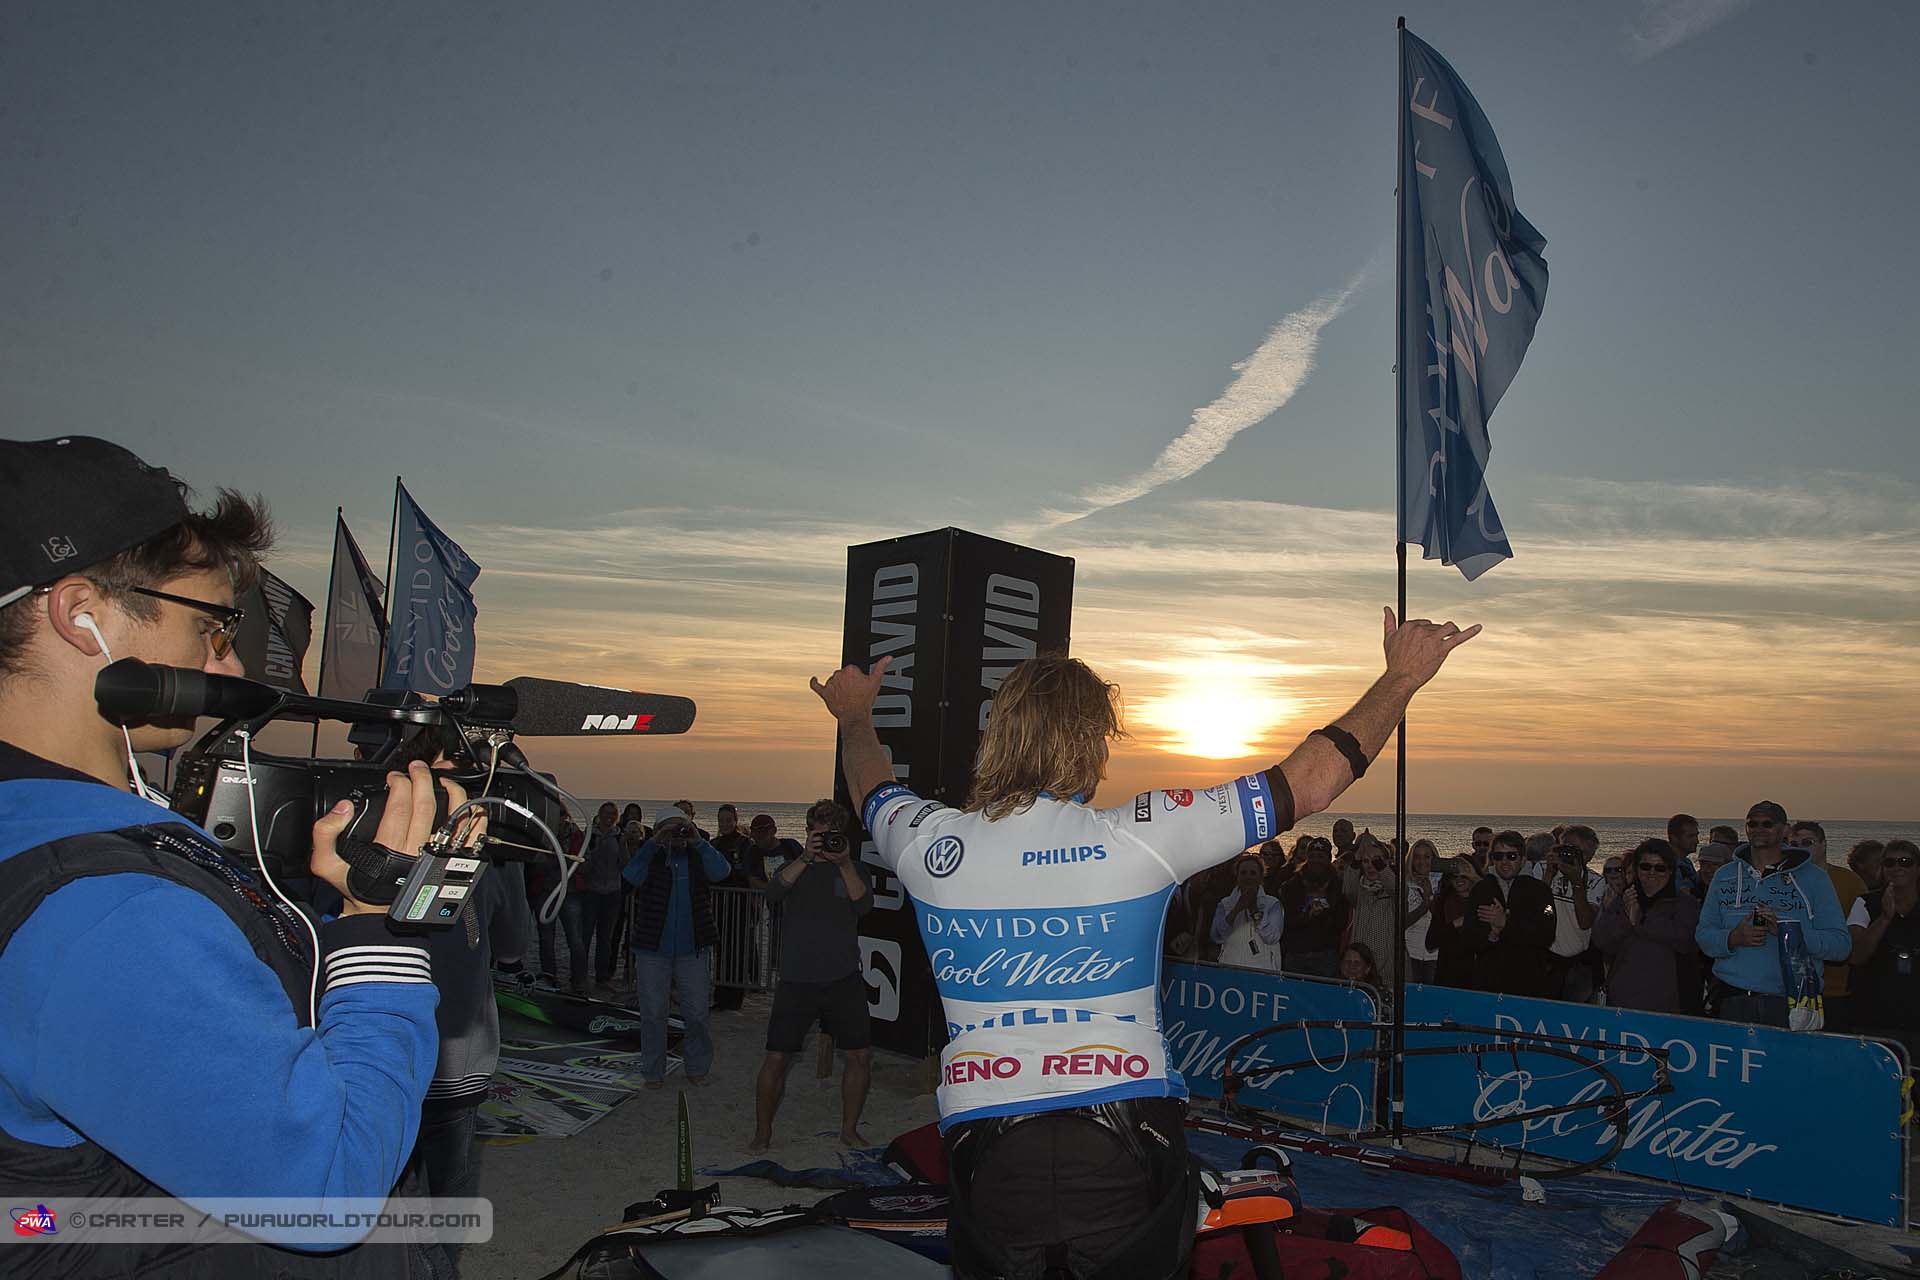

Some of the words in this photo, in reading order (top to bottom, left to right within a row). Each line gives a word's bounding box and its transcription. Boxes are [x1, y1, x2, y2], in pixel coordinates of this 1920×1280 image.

[424, 598, 463, 689] Cool
[869, 562, 919, 728] DAVID
[978, 573, 1040, 730] AVID
[1022, 844, 1107, 867] PHILIPS
[1769, 887, 1798, 899] Surf
[926, 911, 1118, 939] DAVIDOFF
[931, 947, 1007, 987] Cool
[1002, 946, 1136, 988] Water
[1161, 978, 1290, 1021] VIDOFF
[1042, 1054, 1150, 1079] RENO
[1495, 1014, 1768, 1083] DAVIDOFF
[1596, 1097, 1778, 1169] Water
